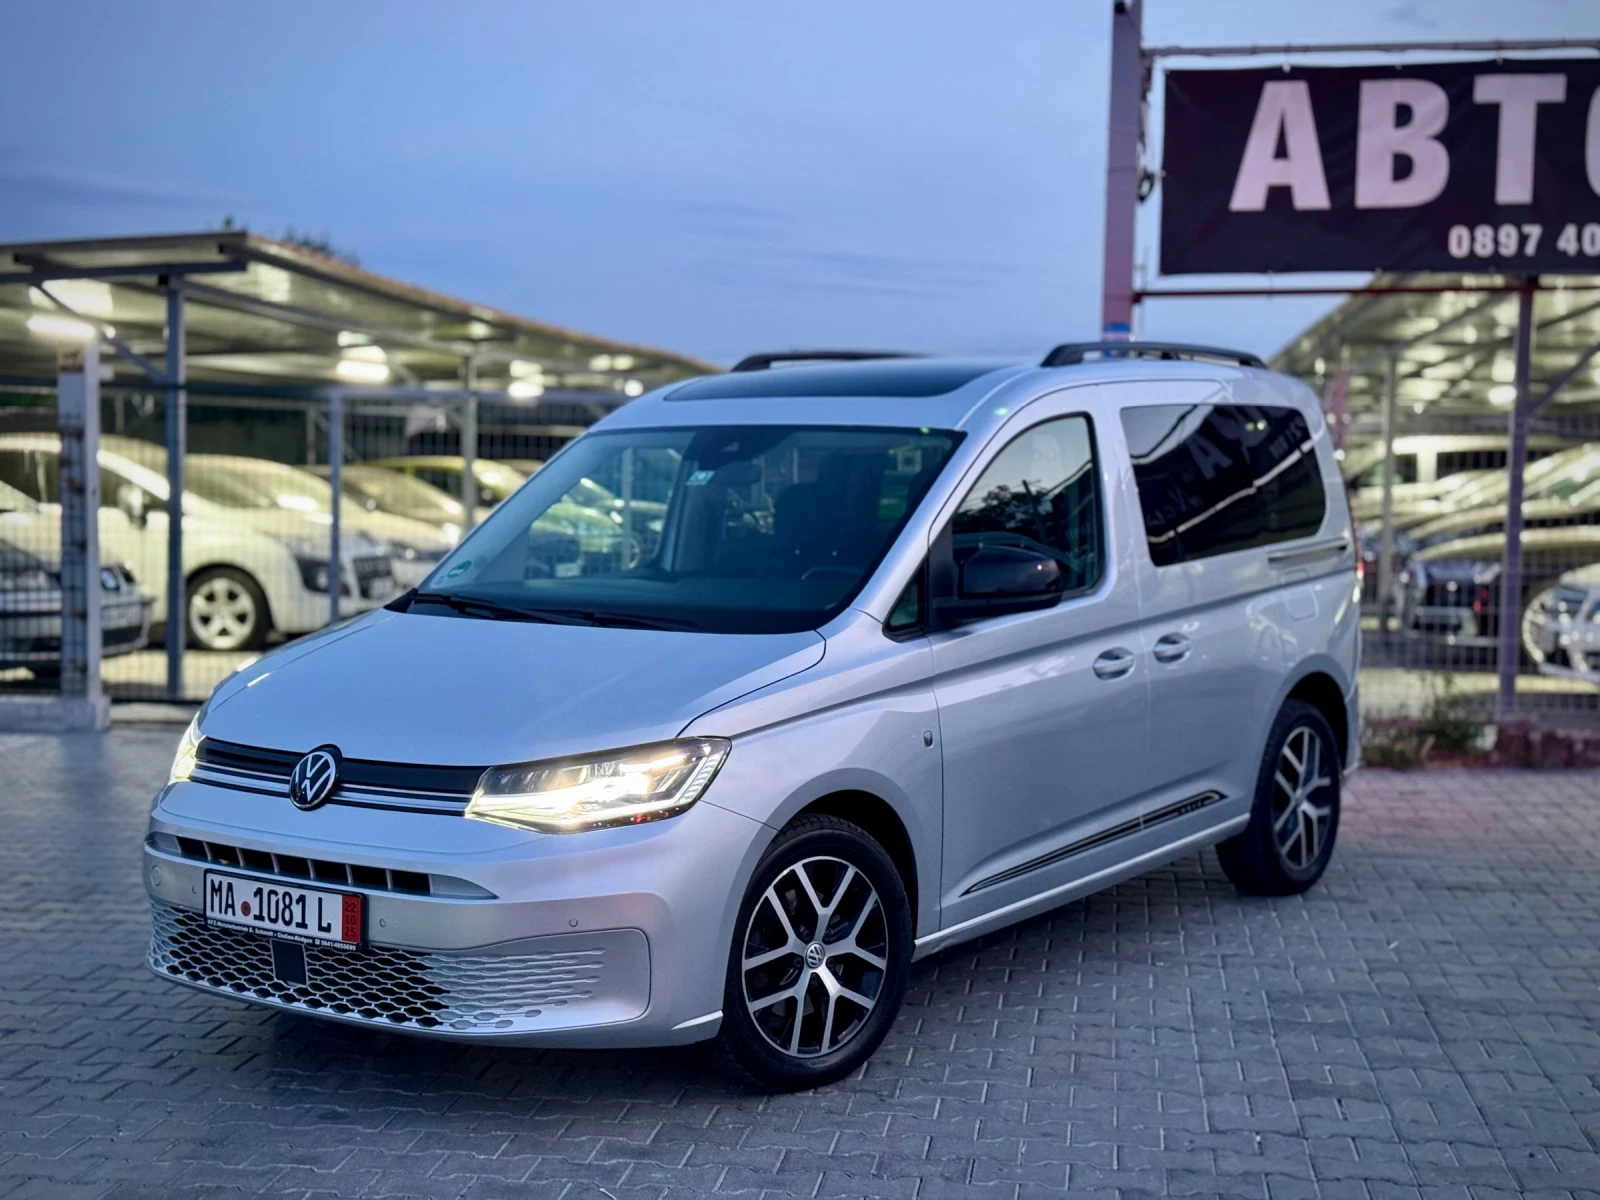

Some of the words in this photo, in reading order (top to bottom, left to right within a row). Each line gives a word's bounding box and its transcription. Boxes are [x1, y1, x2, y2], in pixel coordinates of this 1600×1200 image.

[1229, 74, 1600, 212] АВТ
[1448, 223, 1543, 259] 0897
[1556, 222, 1600, 257] 40
[210, 878, 236, 917] MA
[253, 886, 308, 930] 1081
[317, 896, 332, 933] L
[344, 901, 356, 913] 22
[344, 926, 356, 938] 25
